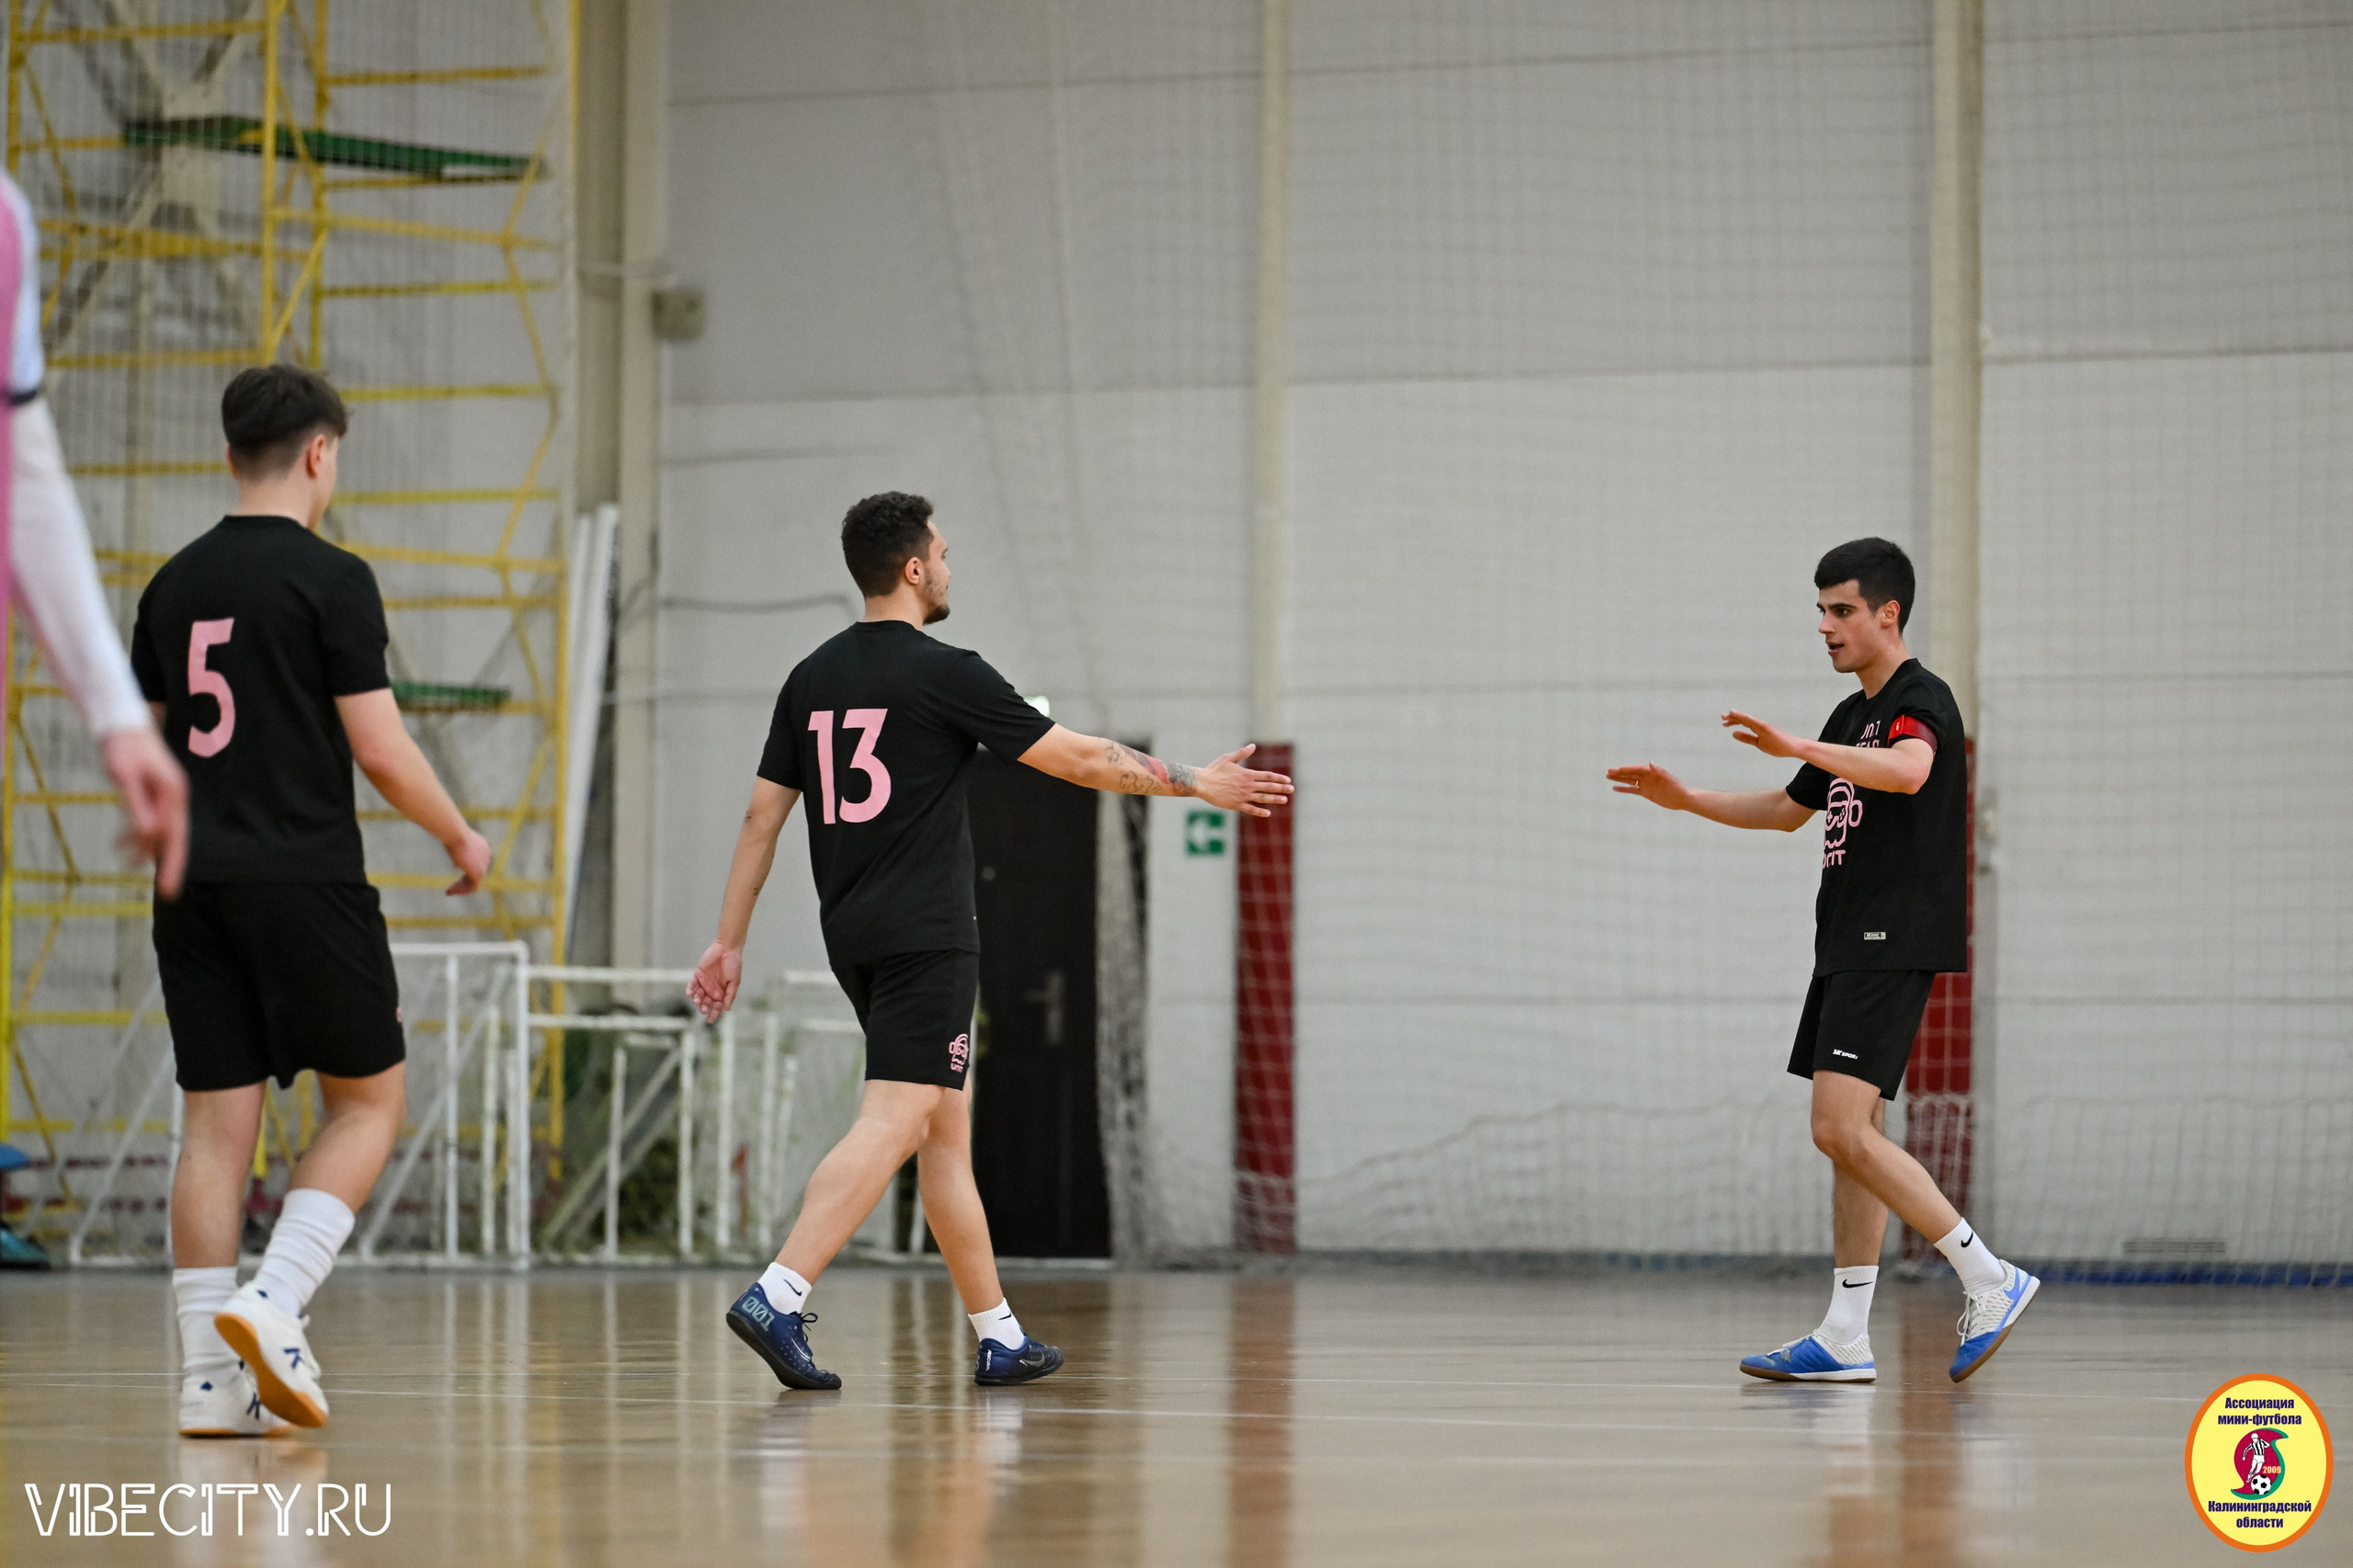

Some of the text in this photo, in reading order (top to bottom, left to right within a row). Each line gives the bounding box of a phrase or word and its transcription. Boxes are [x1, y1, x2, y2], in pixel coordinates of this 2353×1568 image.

[188, 617, 235, 758] 5
[807, 709, 892, 824] 13
[742, 1296, 775, 1332] 001
